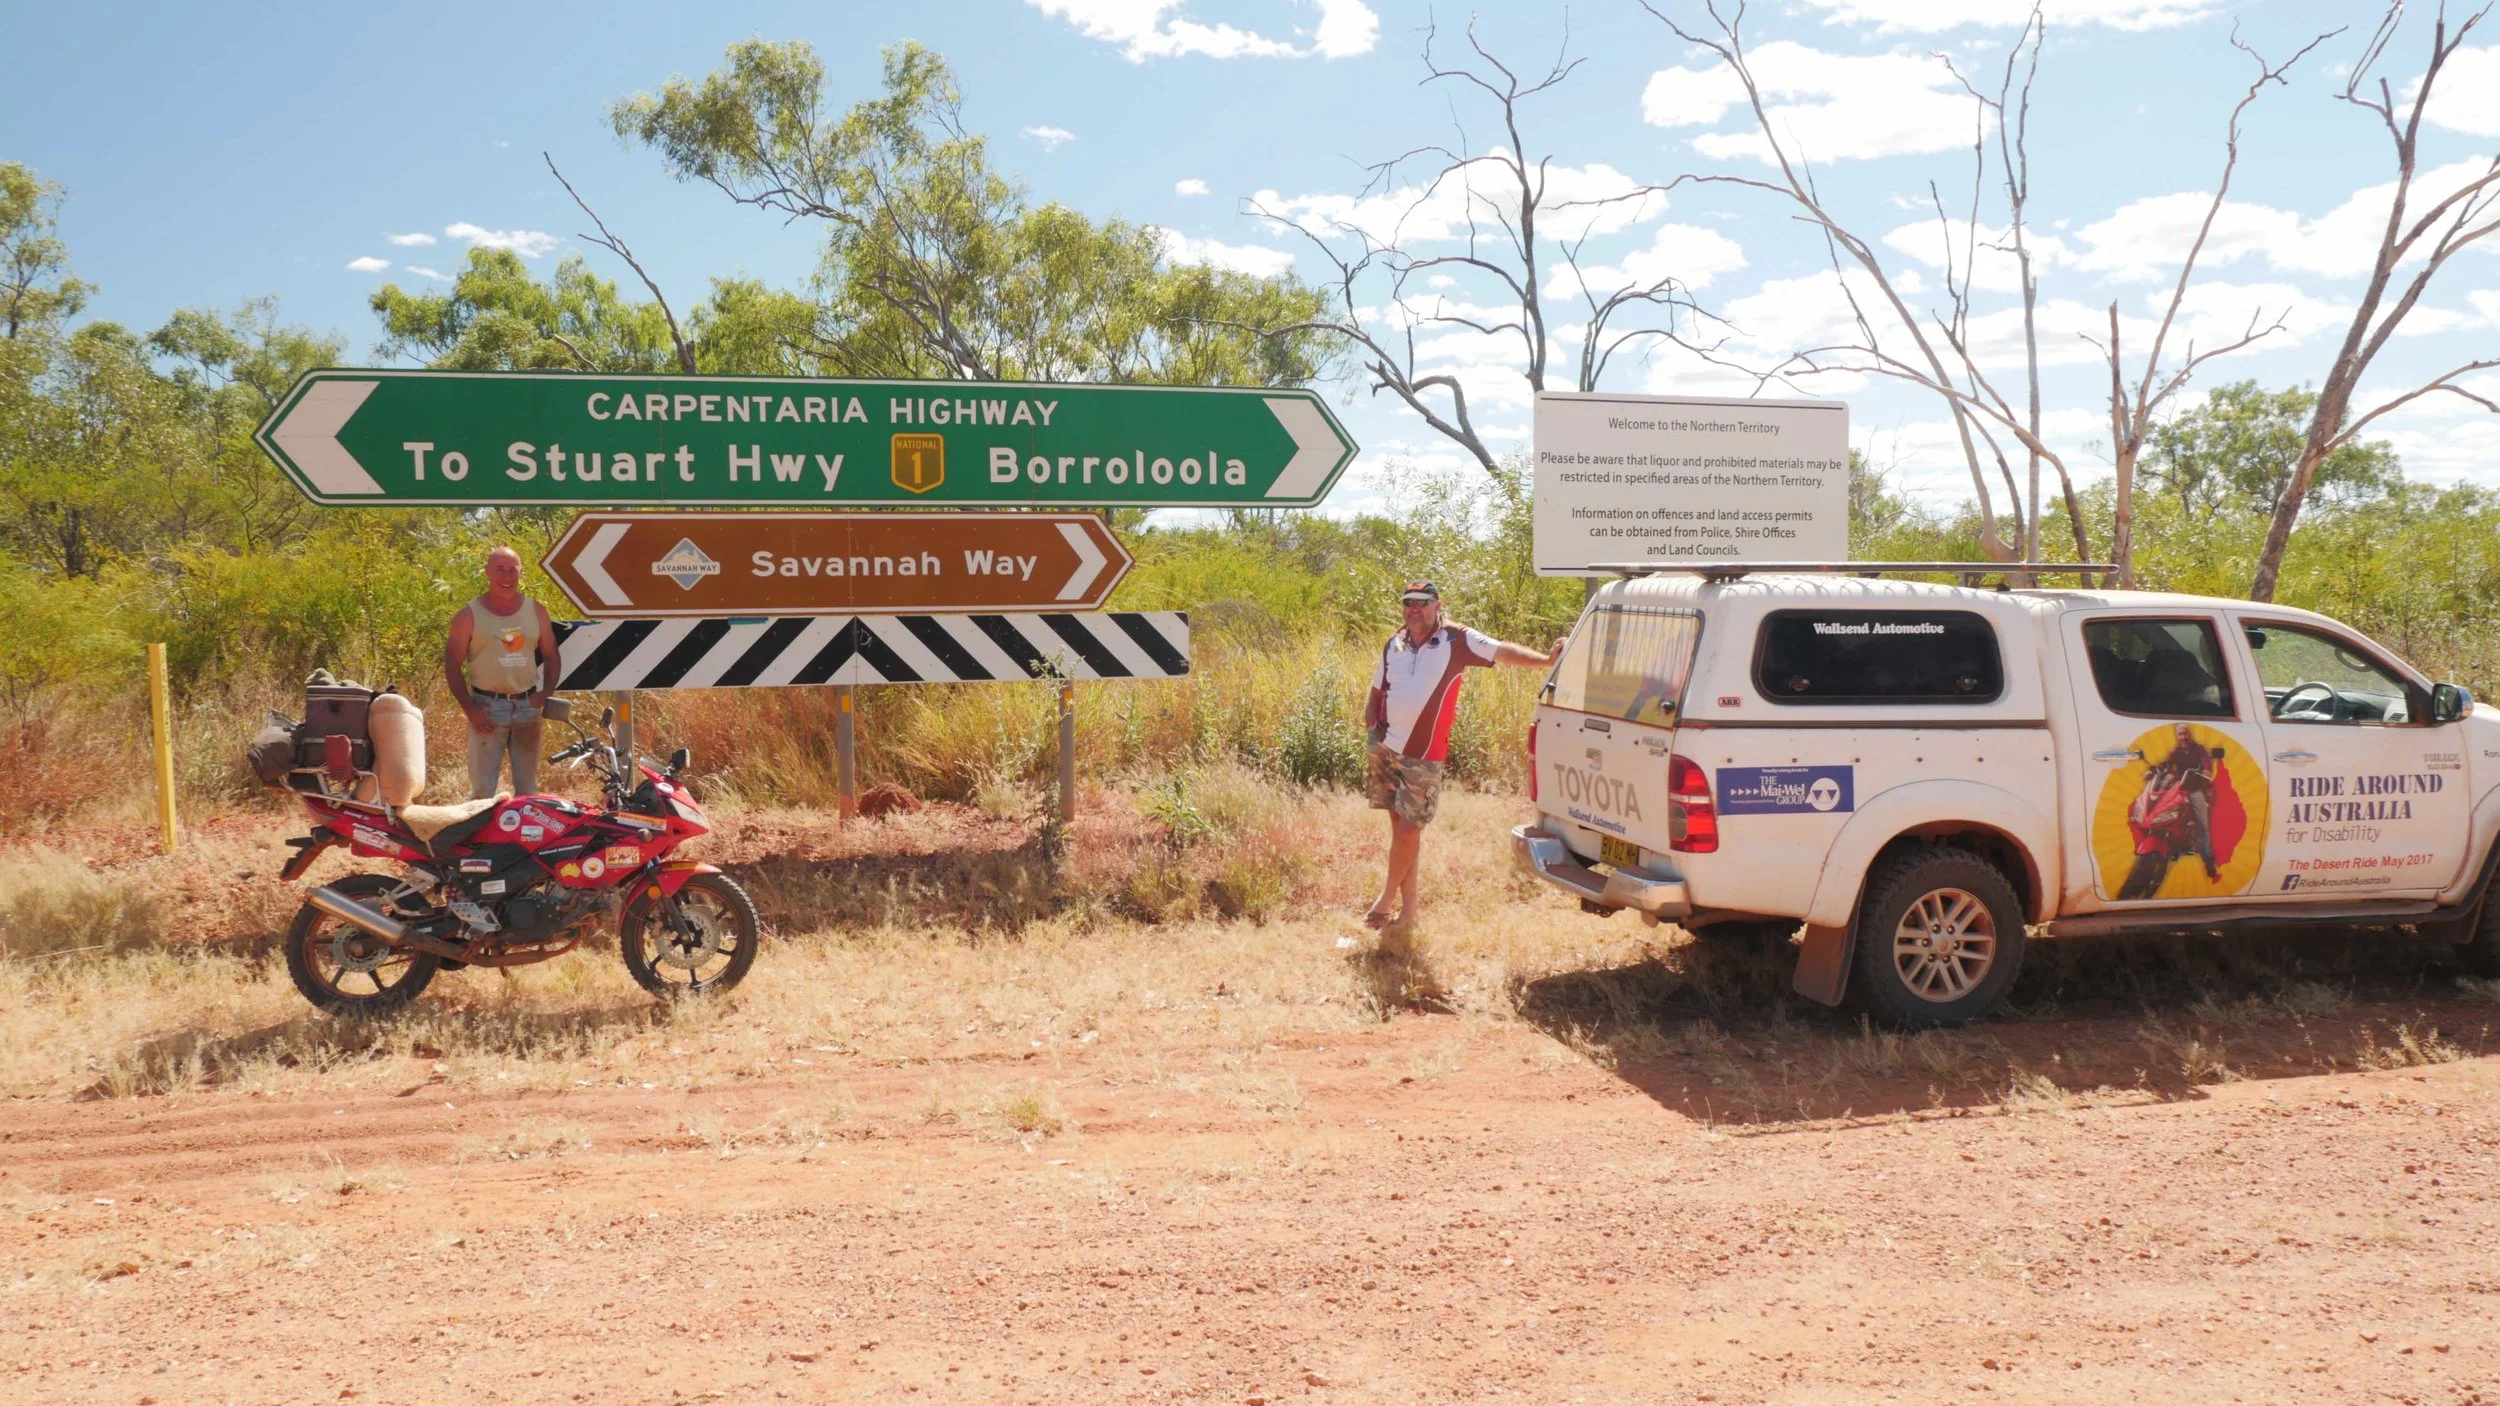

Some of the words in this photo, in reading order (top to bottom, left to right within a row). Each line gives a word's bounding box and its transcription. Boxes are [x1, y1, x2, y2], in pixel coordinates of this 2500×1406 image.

[587, 392, 869, 424] CARPENTARIA
[890, 397, 1059, 426] HIGHWAY
[1607, 416, 1656, 431] Welcome
[1657, 420, 1669, 431] to
[1670, 418, 1689, 432] the
[1689, 419, 1737, 433] Northern
[1737, 421, 1781, 437] Territory
[896, 439, 939, 449] NATIONAL
[402, 441, 469, 482] To
[505, 441, 696, 482] Stuart
[728, 443, 845, 492] Hwy
[911, 451, 922, 484] 1
[989, 446, 1246, 486] Borroloola
[1540, 451, 1575, 465] Please
[1576, 451, 1591, 465] be
[1592, 455, 1625, 466] aware
[1626, 453, 1648, 466] that
[1649, 453, 1681, 469] liquor
[1682, 455, 1702, 467] and
[1703, 455, 1757, 470] prohibited
[1758, 457, 1805, 470] materials
[1806, 460, 1828, 473] may
[1828, 457, 1843, 470] be
[1559, 471, 1611, 484] restricted
[1612, 471, 1623, 484] in
[1624, 471, 1671, 487] specified
[1672, 475, 1700, 485] areas
[1701, 473, 1713, 485] of
[1713, 473, 1731, 486] the
[1732, 474, 1779, 486] Northern
[1779, 474, 1825, 490] Territory.
[1571, 506, 1634, 520] Information
[1635, 510, 1650, 520] on
[1651, 507, 1695, 520] offences
[1695, 508, 1716, 521] and
[1717, 508, 1740, 521] land
[1741, 511, 1774, 521] access
[1774, 510, 1813, 524] permits
[1589, 527, 1608, 537] can
[1610, 525, 1624, 538] be
[1625, 525, 1672, 538] obtained
[1673, 525, 1699, 538] from
[1700, 526, 1733, 539] Police,
[1734, 526, 1761, 539] Shire
[1761, 526, 1797, 539] Offices
[1646, 543, 1667, 556] and
[1668, 543, 1694, 556] Land
[1695, 543, 1741, 556] Councils.
[656, 564, 698, 573] SAVANNAH
[700, 564, 717, 573] WAY
[751, 550, 941, 578] Savannah
[963, 549, 1038, 582] Way
[1812, 622, 1871, 635] Wallsend
[1871, 622, 1945, 635] Automotive
[1759, 775, 1778, 785] THE
[2289, 776, 2345, 798] RIDE
[2351, 773, 2443, 796] AROUND
[1554, 762, 1643, 822] TOYOTA
[1775, 795, 1806, 805] GROUP
[2286, 799, 2412, 824] AUSTRALIA
[2285, 827, 2309, 844] for
[2312, 824, 2383, 844] Disability
[2288, 859, 2309, 871] The
[2312, 858, 2351, 870] Desert
[2352, 856, 2378, 869] Ride
[2380, 855, 2405, 869] May
[2406, 853, 2434, 866] 2017
